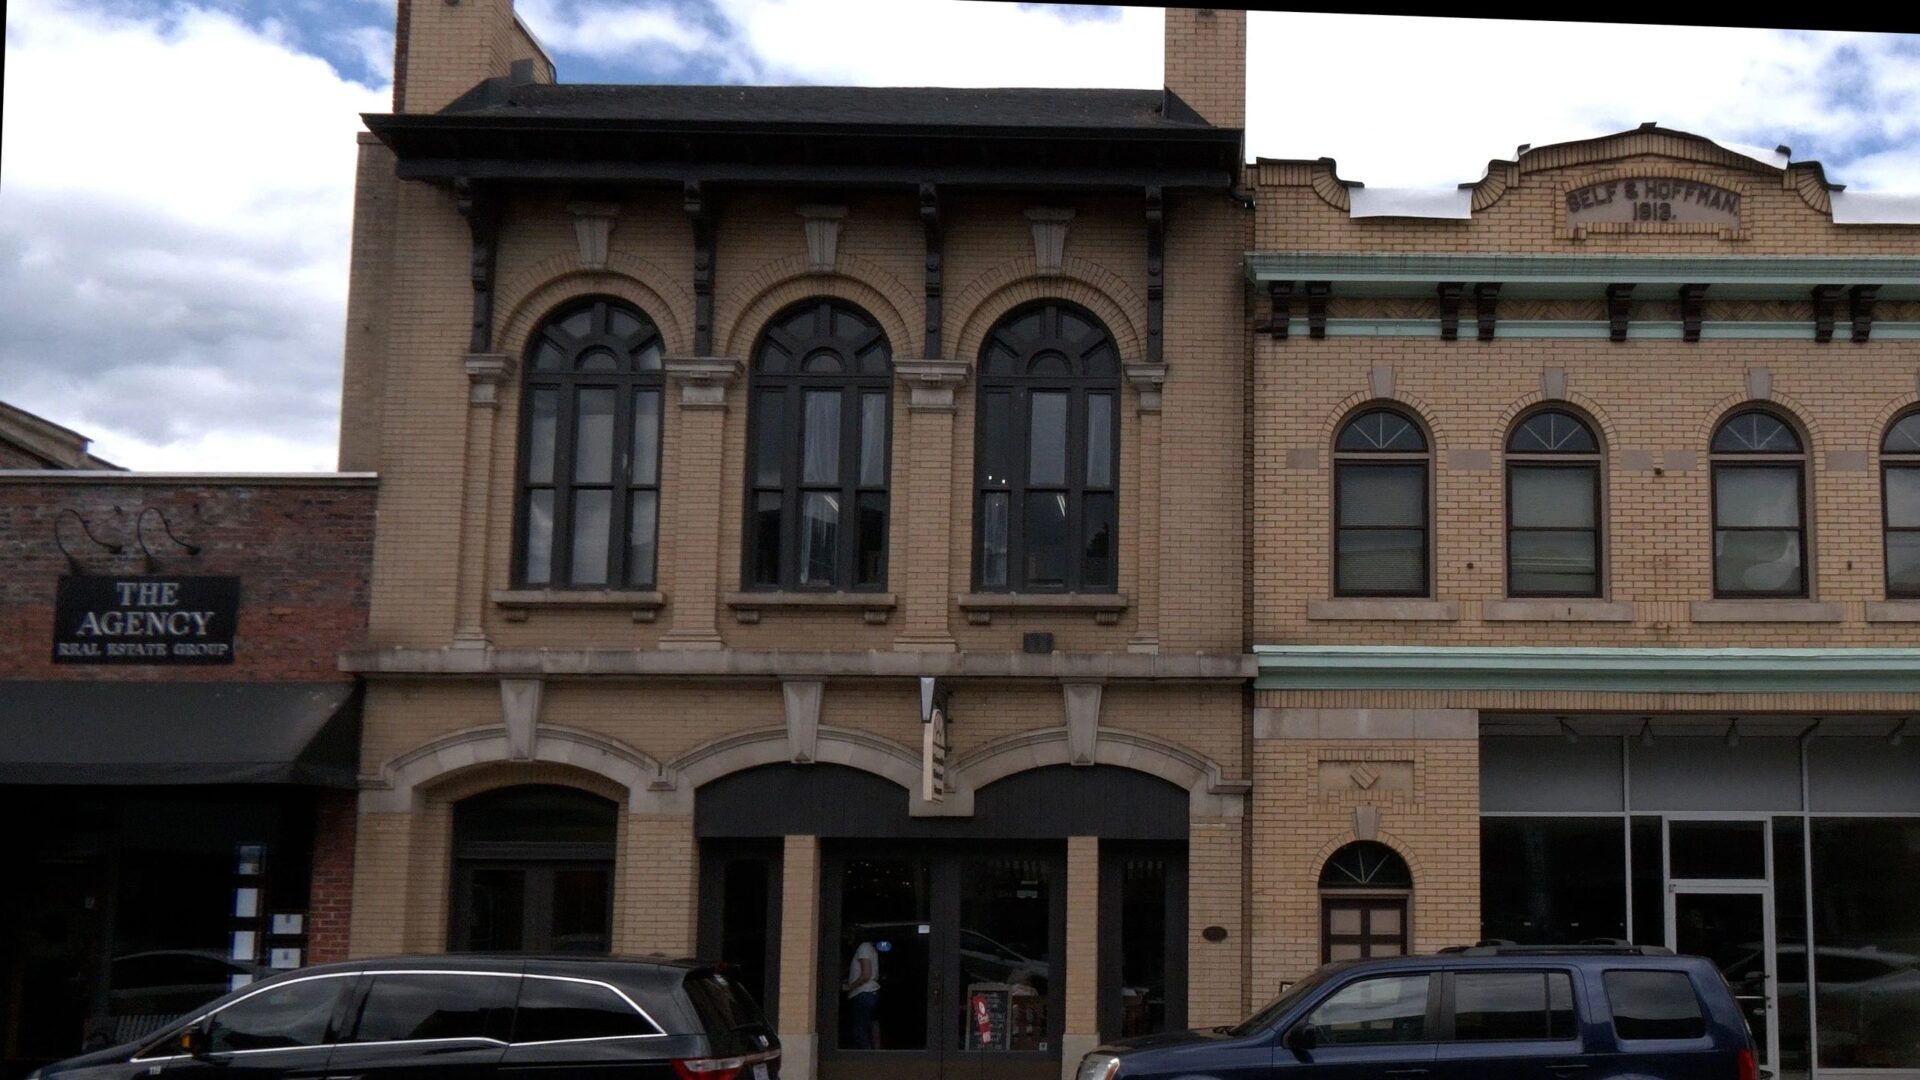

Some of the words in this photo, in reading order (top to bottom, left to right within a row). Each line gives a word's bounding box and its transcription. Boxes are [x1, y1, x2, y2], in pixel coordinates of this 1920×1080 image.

[1566, 182, 1618, 213] SELF
[1624, 181, 1639, 201] &
[117, 582, 178, 606] THE
[76, 611, 214, 635] AGENCY
[58, 643, 101, 656] REAL
[107, 643, 167, 657] ESTATE
[172, 643, 229, 657] GROUP
